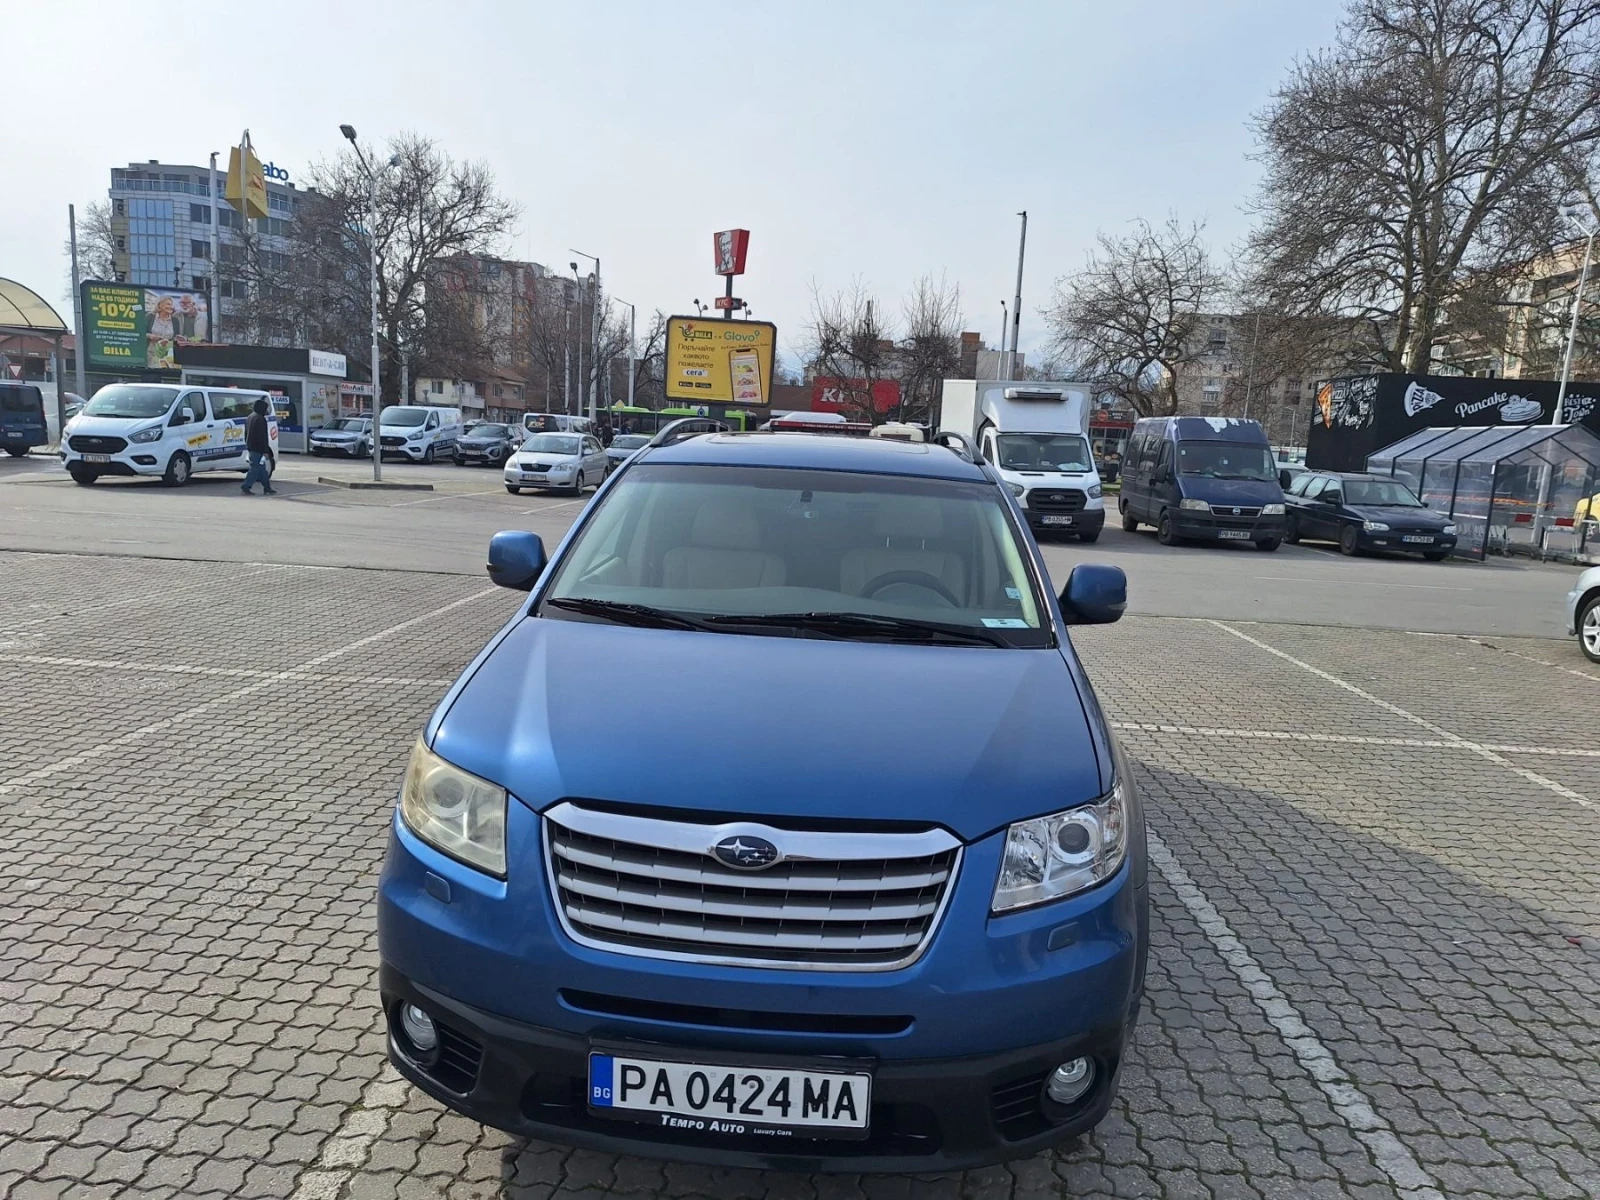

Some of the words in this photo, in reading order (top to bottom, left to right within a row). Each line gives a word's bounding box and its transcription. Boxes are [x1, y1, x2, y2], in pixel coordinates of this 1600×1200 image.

[716, 298, 728, 307] KFC
[92, 302, 137, 319] -10%
[723, 330, 755, 342] Glovo
[103, 346, 131, 356] BILLA
[678, 343, 716, 352] Поръчайте
[312, 356, 345, 371] RENT-A-CAR
[678, 361, 714, 369] пожелаете
[1411, 388, 1425, 411] PIZZA
[1454, 391, 1508, 418] Pancake
[593, 1086, 611, 1099] BG
[619, 1063, 675, 1107] PA
[685, 1071, 792, 1118] 0424
[802, 1077, 858, 1121] MA
[661, 1114, 705, 1130] TEMPO
[709, 1120, 745, 1134] AUTO
[753, 1128, 775, 1136] Luxury
